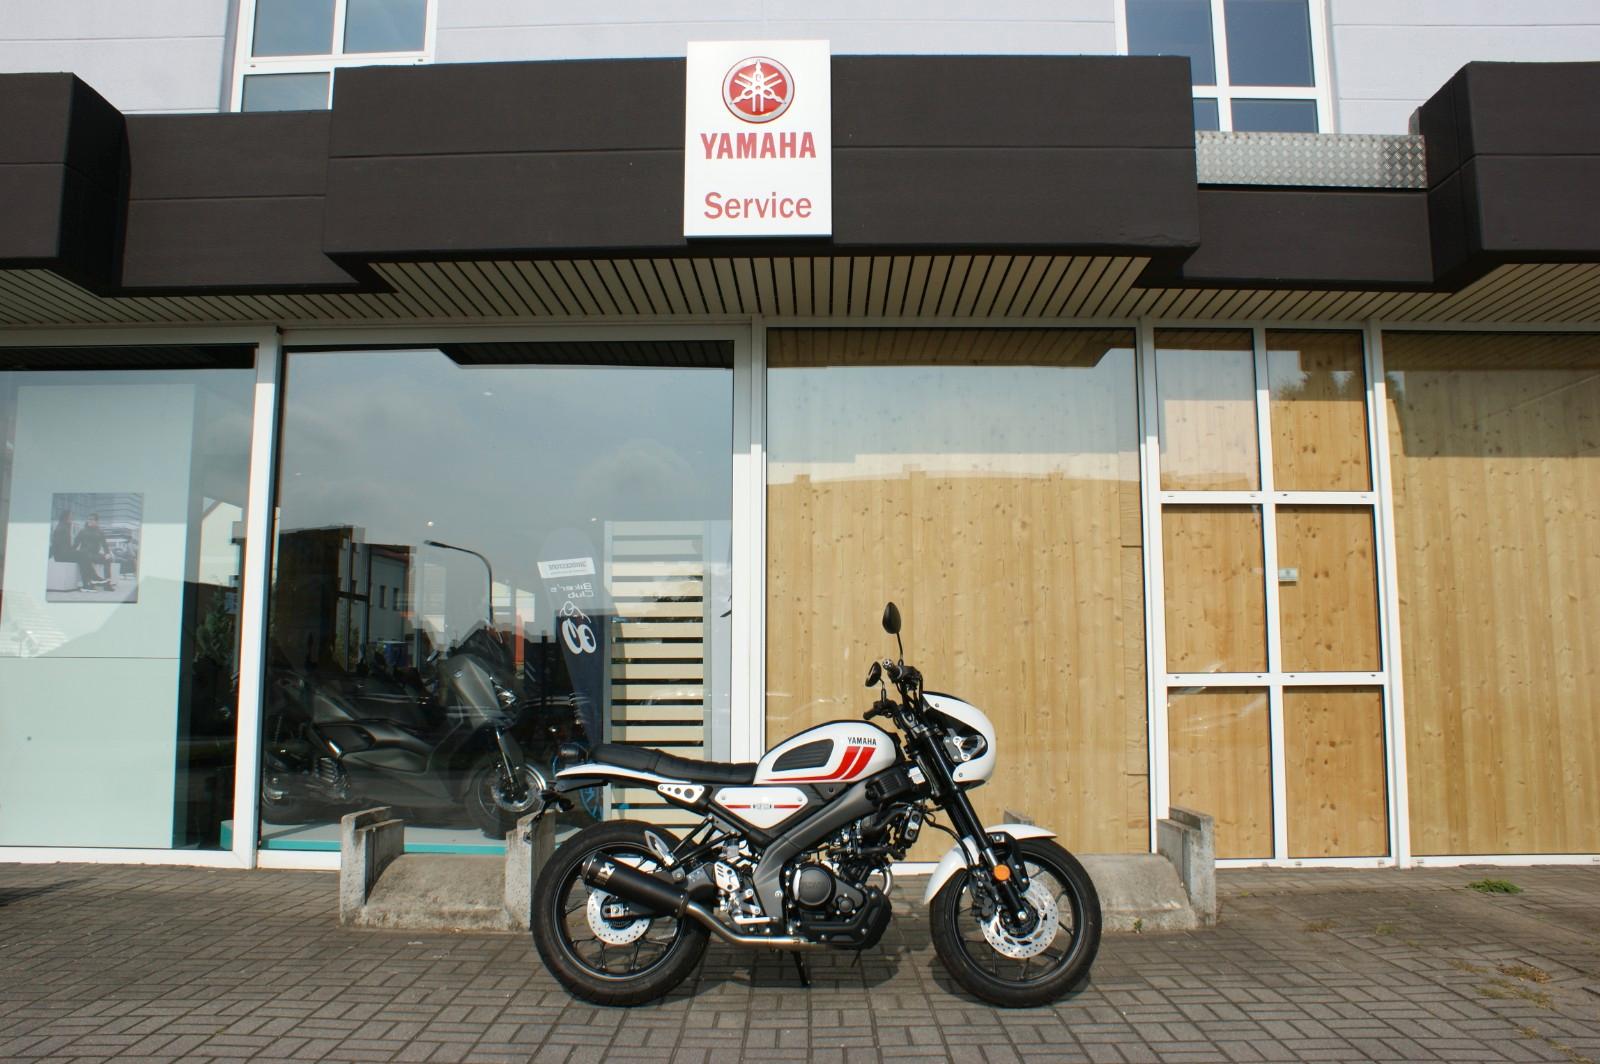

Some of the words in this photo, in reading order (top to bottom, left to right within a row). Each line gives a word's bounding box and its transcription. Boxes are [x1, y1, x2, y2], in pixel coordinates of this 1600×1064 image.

[700, 132, 816, 159] YAMAHA
[704, 191, 812, 219] Service
[847, 736, 877, 746] YAMAHA
